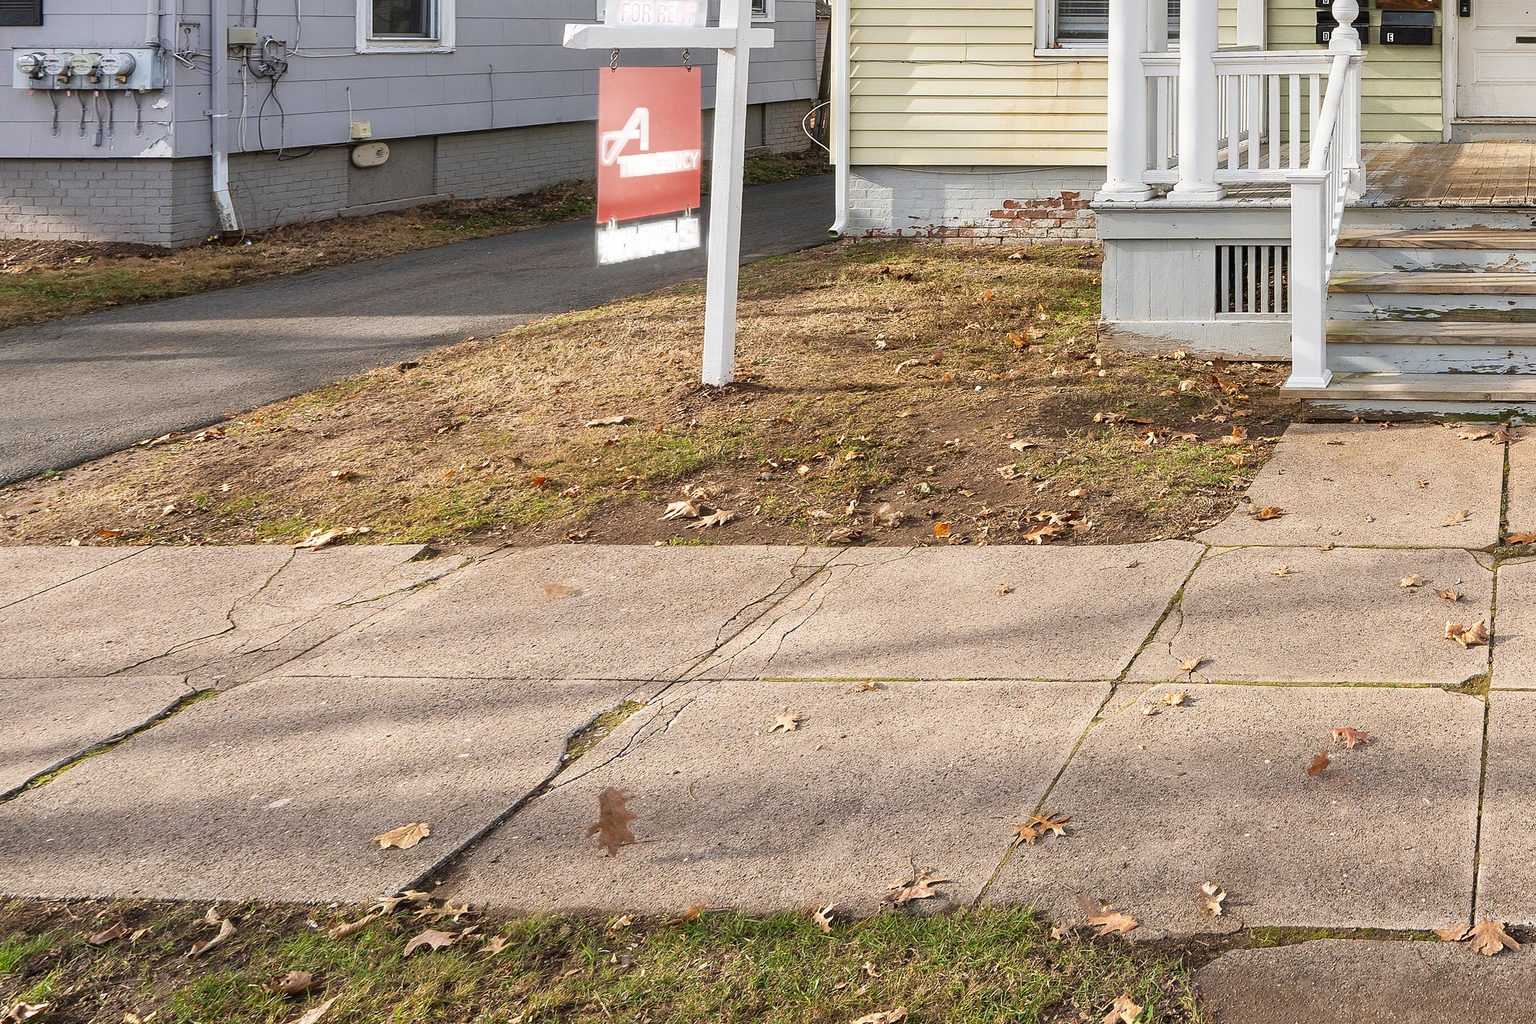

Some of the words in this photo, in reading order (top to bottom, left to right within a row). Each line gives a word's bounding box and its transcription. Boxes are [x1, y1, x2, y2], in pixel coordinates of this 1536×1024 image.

[620, 2, 651, 22] FOR
[656, 4, 697, 23] RENT
[1387, 33, 1393, 42] E
